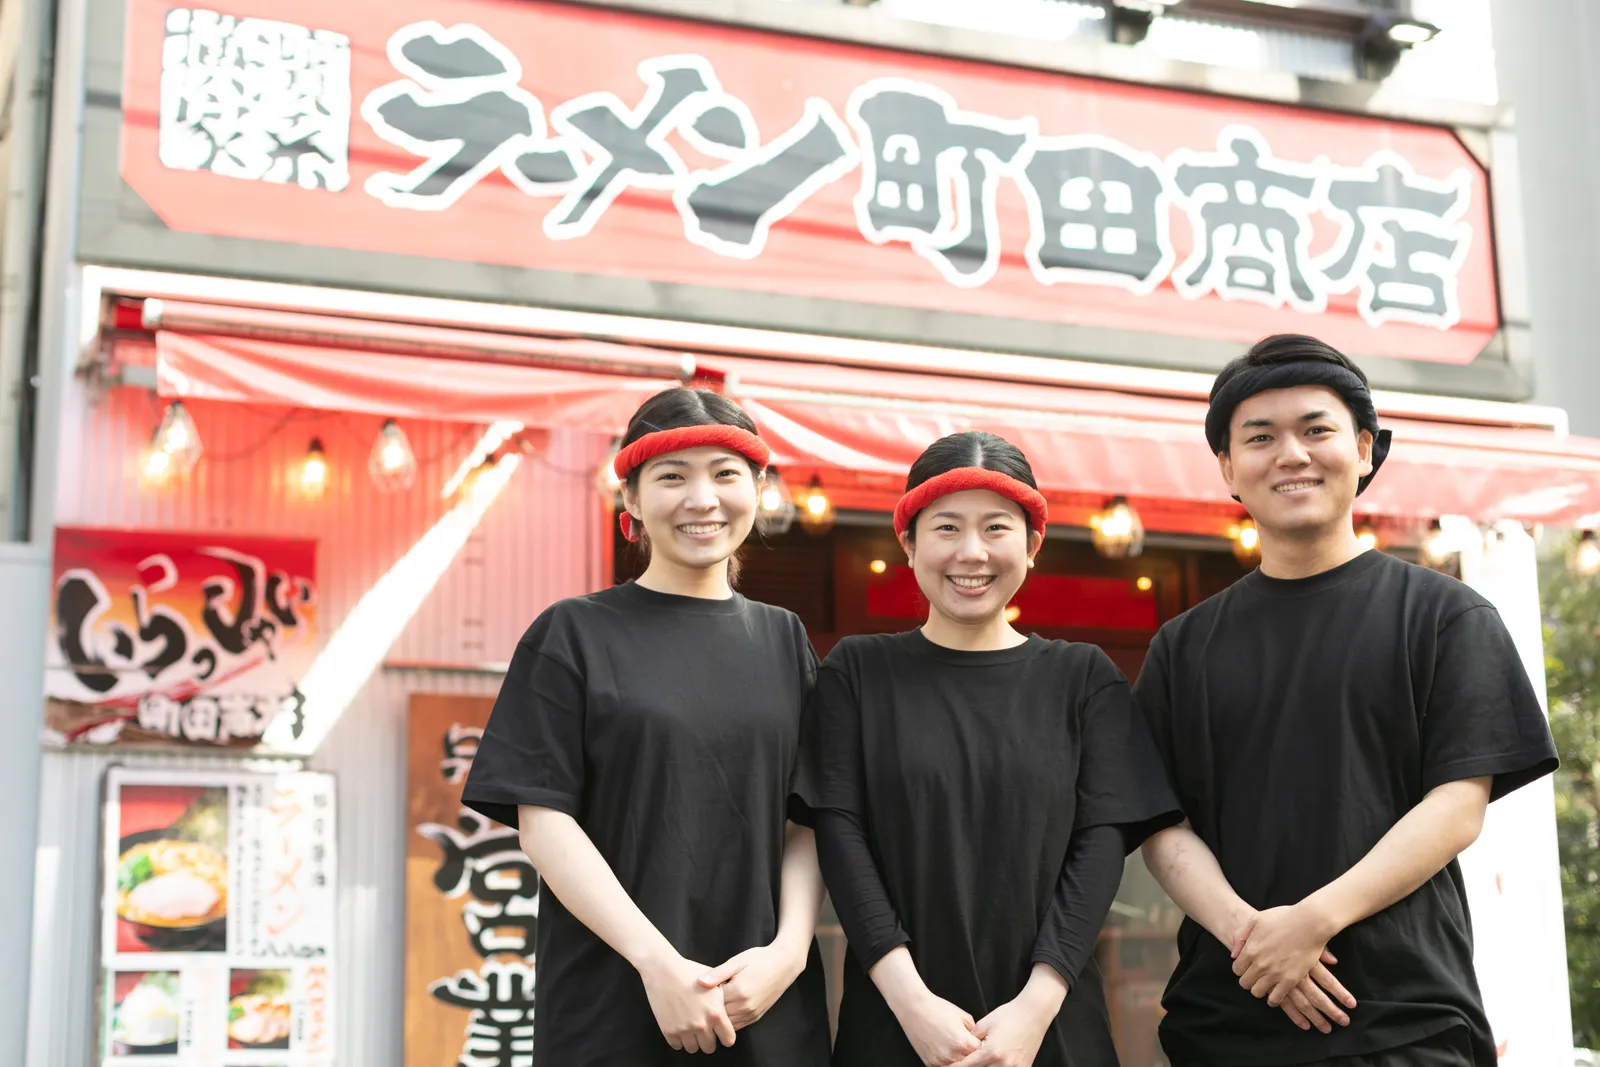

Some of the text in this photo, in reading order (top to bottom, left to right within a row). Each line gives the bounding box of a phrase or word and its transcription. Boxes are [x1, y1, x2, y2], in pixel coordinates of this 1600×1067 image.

[363, 21, 1472, 328] ラーメン町田商店
[267, 788, 304, 936] ラーメン
